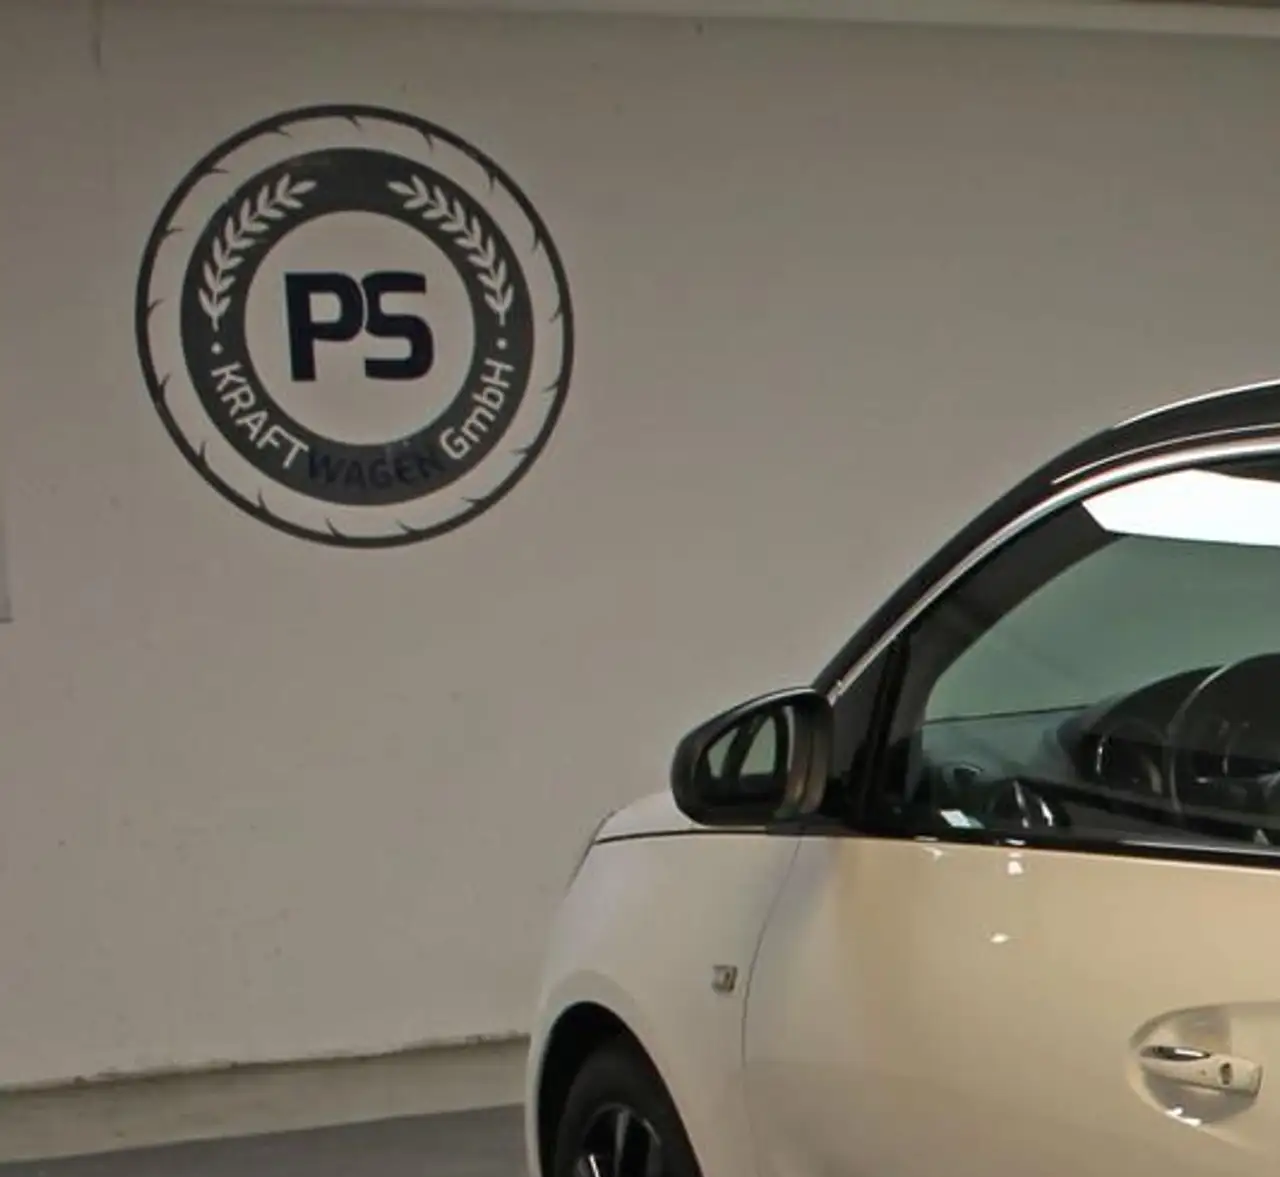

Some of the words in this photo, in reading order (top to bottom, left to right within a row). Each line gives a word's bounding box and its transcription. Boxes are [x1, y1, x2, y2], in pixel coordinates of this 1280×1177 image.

[283, 270, 436, 383] PS
[210, 360, 310, 469] KRAFT
[307, 447, 447, 491] WAGEN
[437, 359, 516, 461] GmbH
